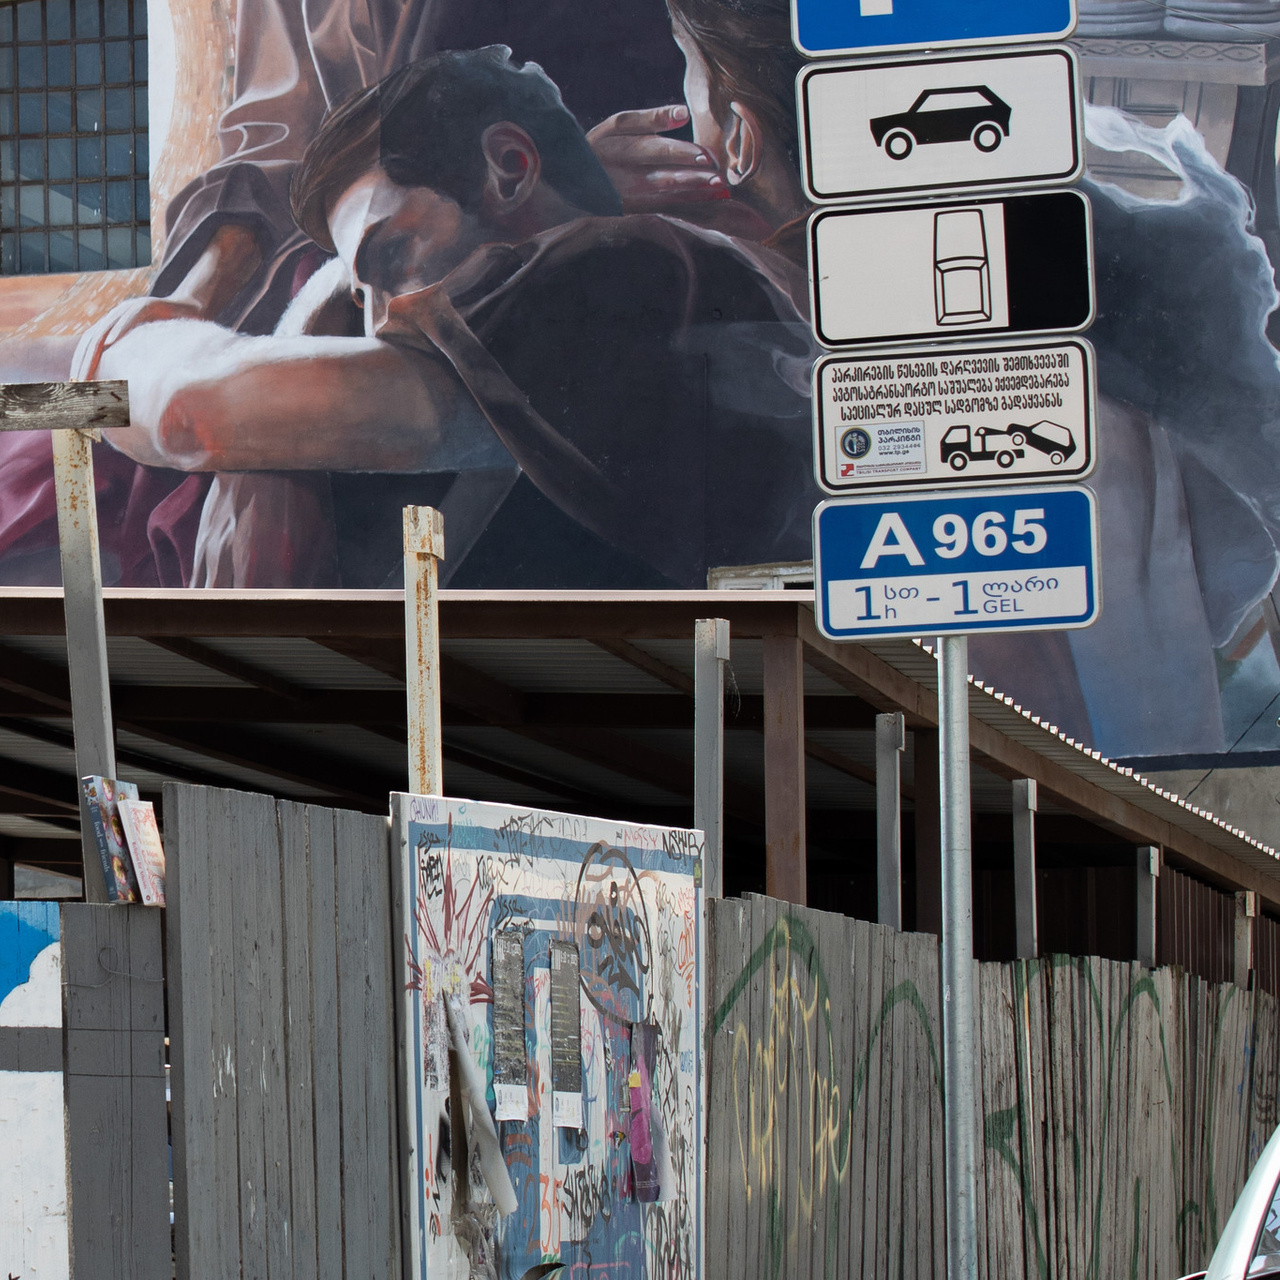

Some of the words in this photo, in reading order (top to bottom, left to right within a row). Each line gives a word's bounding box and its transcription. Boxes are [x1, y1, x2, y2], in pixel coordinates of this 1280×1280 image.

[832, 365, 894, 383] პარკირების
[896, 362, 938, 380] წესების
[940, 358, 1000, 376] დარღვევის
[938, 378, 992, 396] საშუალება
[995, 373, 1070, 391] ექვემდებარება
[840, 403, 901, 421] სპეციალურ
[903, 400, 942, 416] დაცულ
[859, 512, 926, 569] A
[932, 507, 1048, 560] 965
[854, 585, 881, 620] 1
[884, 585, 919, 600] სთ
[952, 580, 979, 615] 1
[982, 576, 1059, 598] ლარი
[983, 598, 1024, 614] GEL
